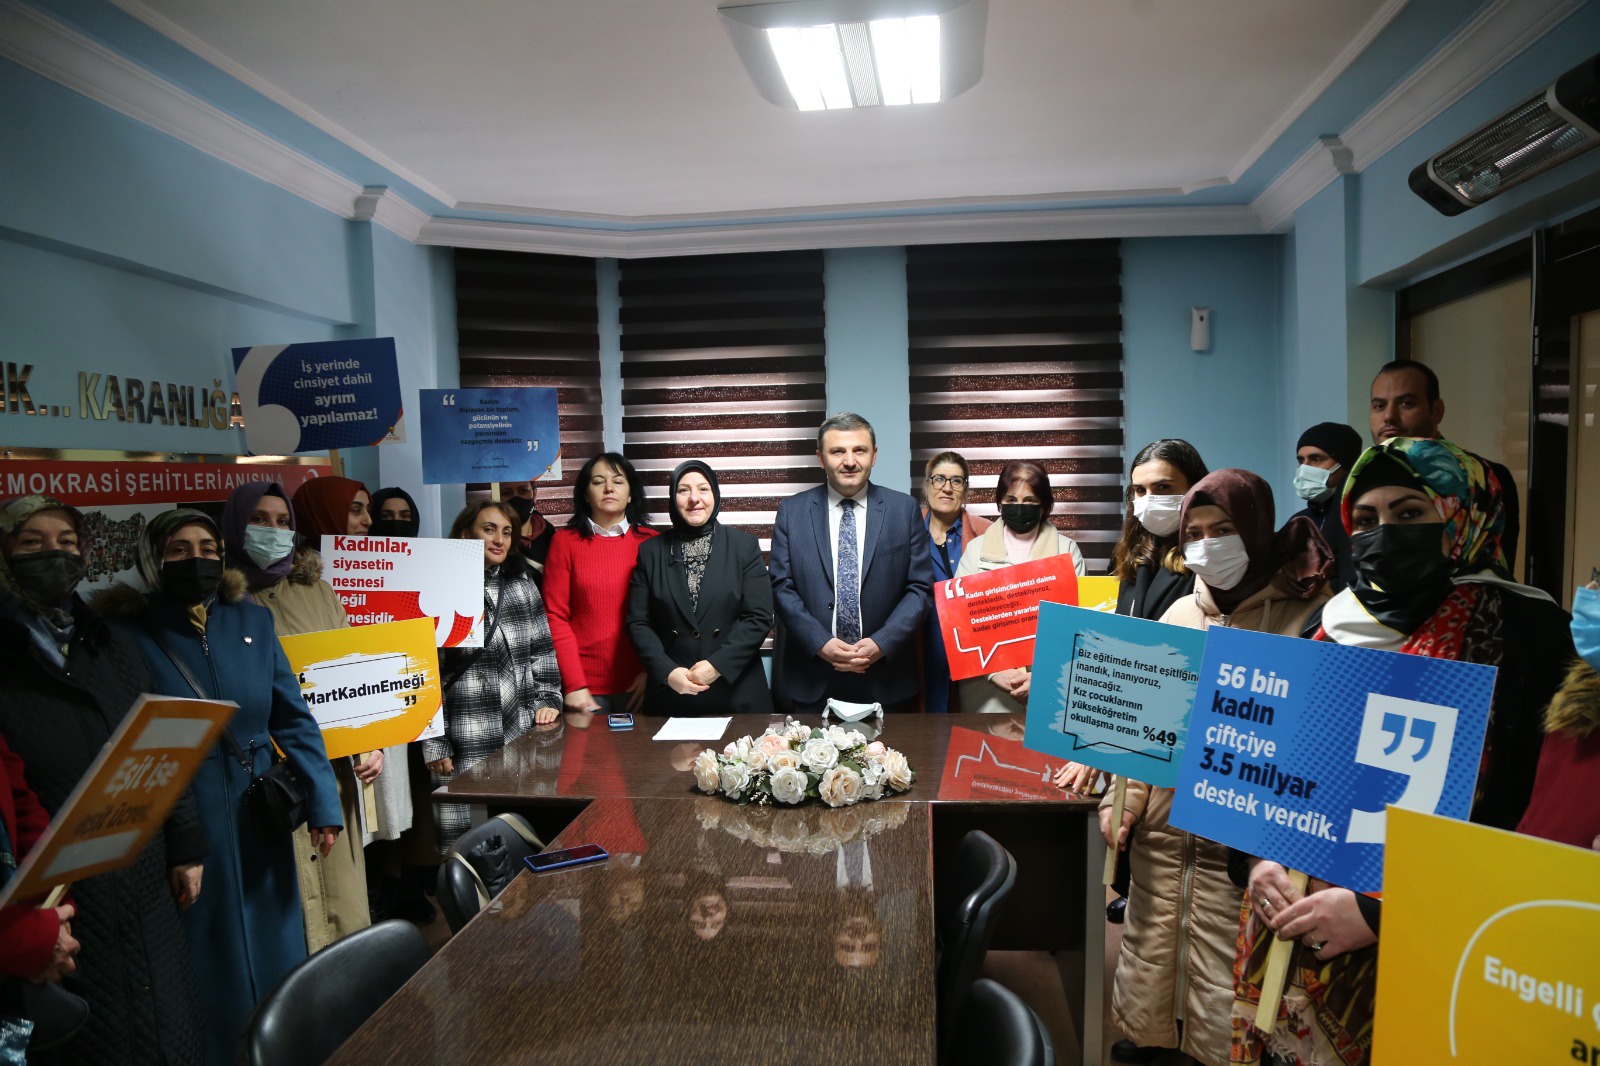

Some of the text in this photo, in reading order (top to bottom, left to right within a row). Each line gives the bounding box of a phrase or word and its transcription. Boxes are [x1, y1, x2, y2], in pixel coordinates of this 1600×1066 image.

[301, 359, 360, 374] İş yerinde
[293, 373, 372, 389] cinsiyet dahil
[78, 371, 245, 430] KARANLIĞA
[315, 394, 356, 408] ayrım
[300, 408, 378, 428] yapılamaz!
[125, 469, 222, 497] ŞEHİTLERİ
[334, 536, 412, 556] Kadınlar,
[332, 557, 394, 572] siyasetin
[332, 577, 385, 588] nesnesi
[965, 575, 1056, 599] Kadın girişimcilerimizi daima
[969, 601, 1022, 616] destekleyeceğiz.
[971, 605, 1040, 625] Desteklerden yararlan
[973, 625, 992, 633] kadın
[992, 619, 1020, 630] girişimci
[1078, 648, 1092, 659] Biz
[1093, 651, 1132, 668] eğitimde
[1134, 659, 1158, 674] fırsat
[1075, 674, 1123, 693] inanacağız.
[1076, 661, 1162, 690] inandık, inanıyoruz,
[1216, 663, 1289, 698] 56 bin
[1073, 686, 1143, 711] Kız çocuklarının
[1211, 690, 1275, 725] kadın
[1072, 699, 1137, 723] yükseköğretim
[1070, 713, 1178, 747] okullaşma oranı %49
[1205, 723, 1277, 758] çiftçiye
[1199, 747, 1317, 800] 3.5 milyar
[1193, 779, 1338, 842] destek verdik.
[1484, 955, 1583, 1017] Engelli
